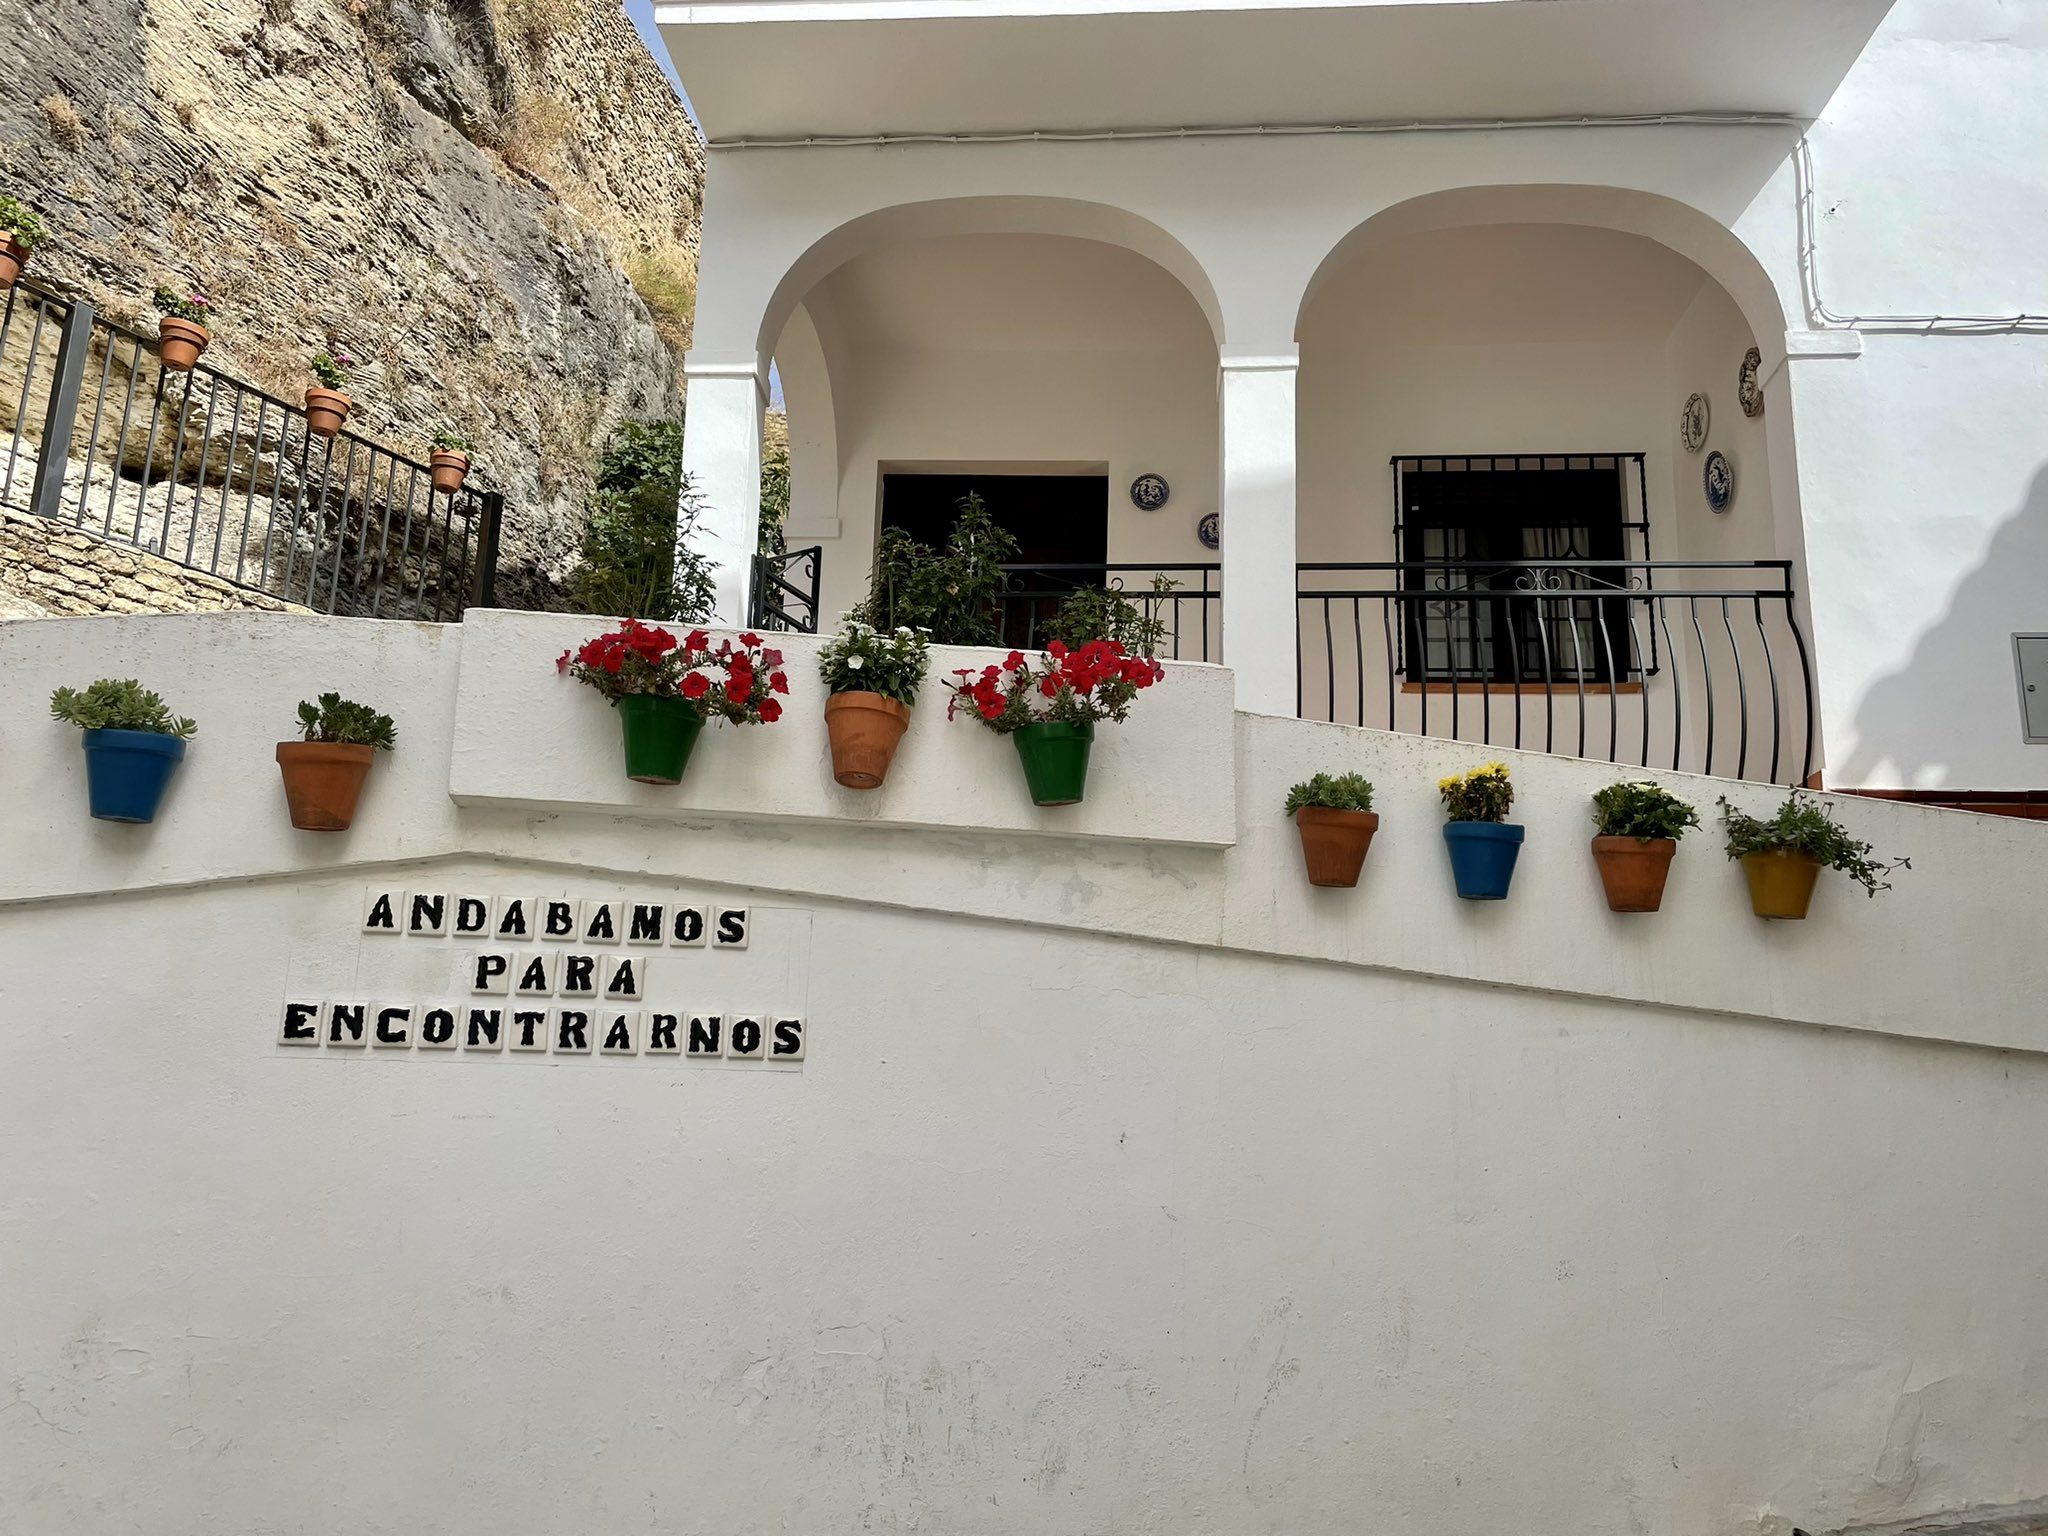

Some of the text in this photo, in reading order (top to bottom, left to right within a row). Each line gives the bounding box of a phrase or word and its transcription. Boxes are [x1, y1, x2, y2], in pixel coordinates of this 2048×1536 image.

[366, 893, 746, 944] ANDABAMOS
[475, 955, 637, 995] PARA
[283, 1003, 803, 1055] ENCONTRARNOS
